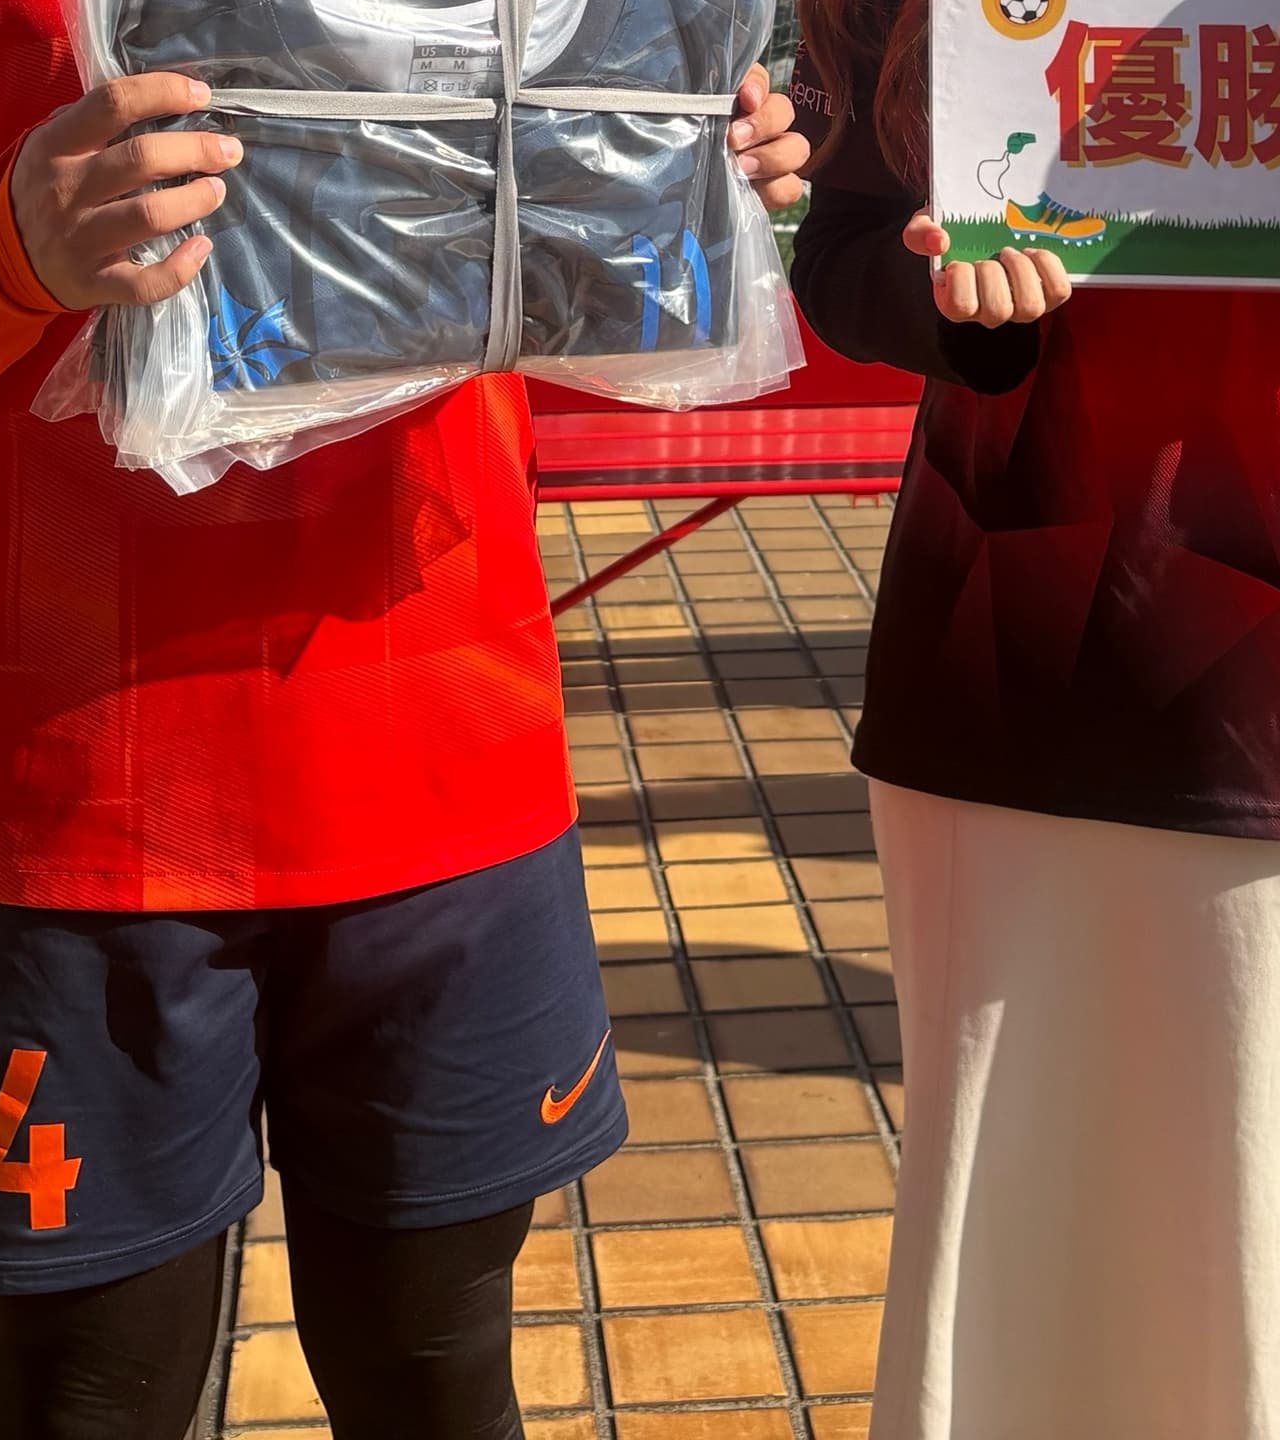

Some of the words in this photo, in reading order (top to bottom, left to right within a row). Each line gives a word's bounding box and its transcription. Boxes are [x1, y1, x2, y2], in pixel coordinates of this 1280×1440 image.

[421, 47, 437, 57] US
[454, 47, 470, 56] EU
[421, 61, 433, 70] M
[453, 60, 466, 70] M
